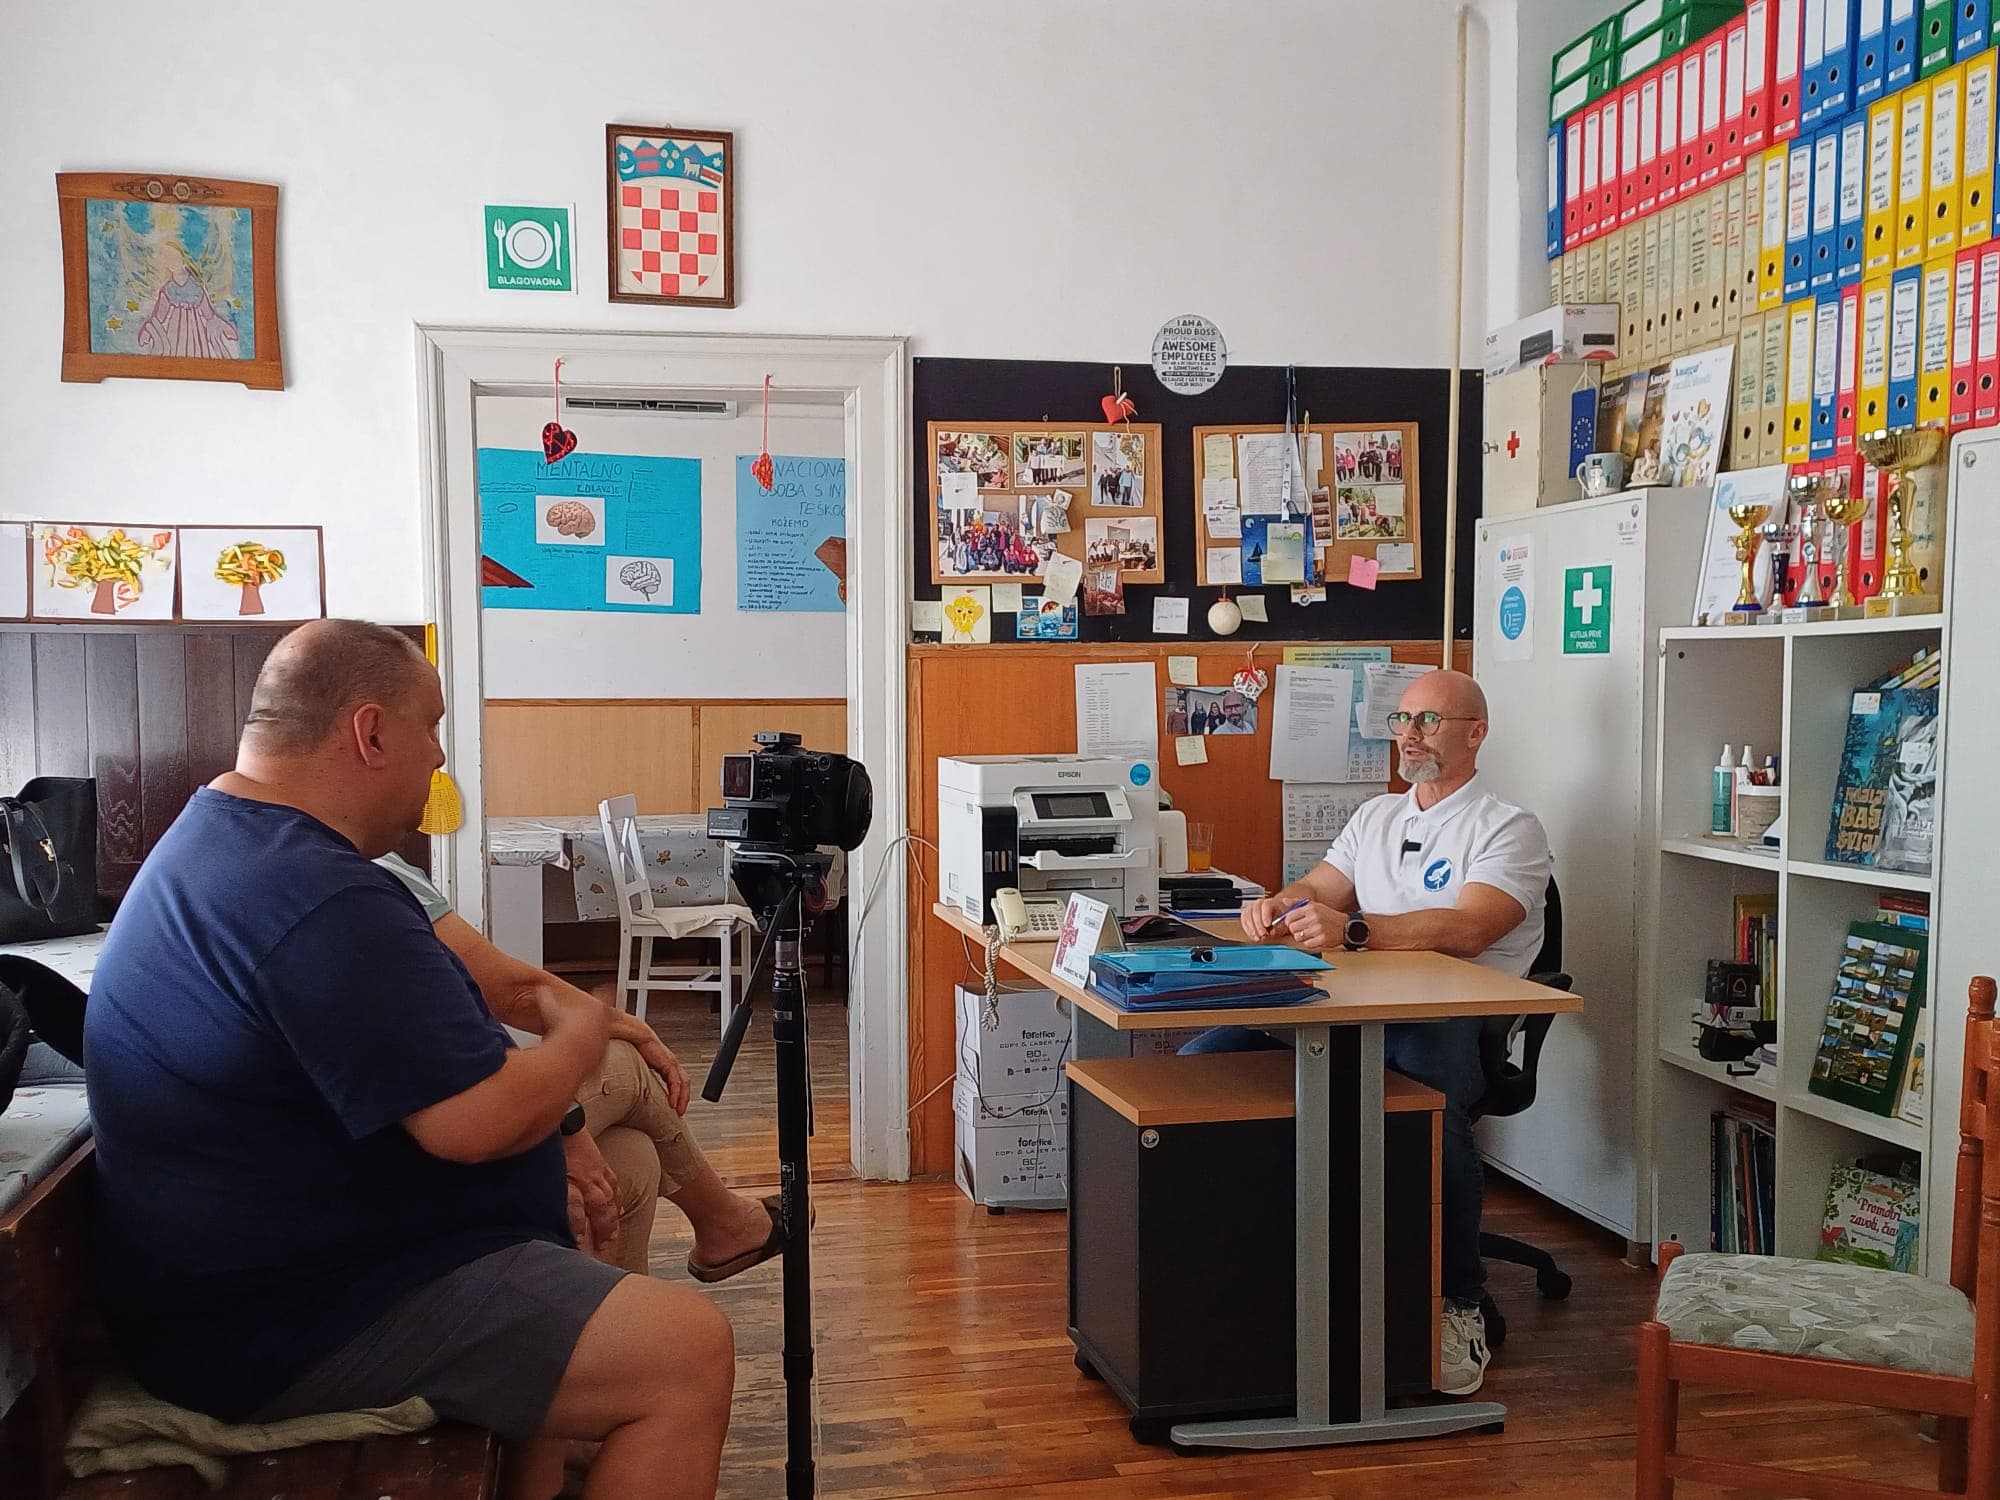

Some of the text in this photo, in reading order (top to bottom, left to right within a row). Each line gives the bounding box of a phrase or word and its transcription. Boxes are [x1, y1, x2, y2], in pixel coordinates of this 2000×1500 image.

[497, 275, 563, 286] BLAGOVAONA
[1181, 319, 1195, 327] AM
[1196, 319, 1203, 327] A
[1163, 327, 1216, 336] PROUD BOSS
[1161, 341, 1217, 352] AWESOME
[1161, 352, 1217, 361] EMPLOYEES
[536, 460, 623, 479] MENTALNO
[814, 483, 823, 497] S
[1026, 1049, 1042, 1058] 80
